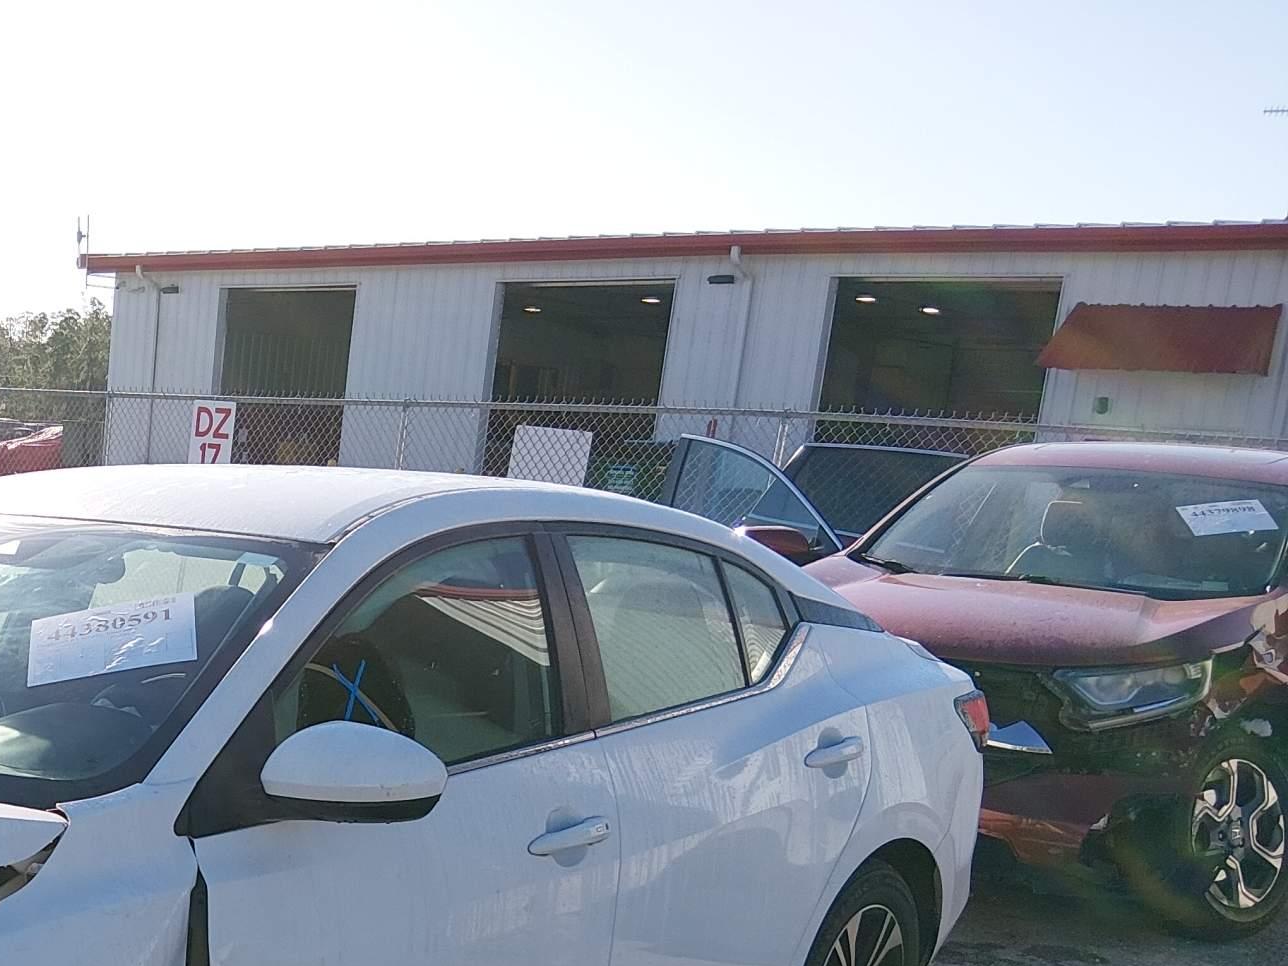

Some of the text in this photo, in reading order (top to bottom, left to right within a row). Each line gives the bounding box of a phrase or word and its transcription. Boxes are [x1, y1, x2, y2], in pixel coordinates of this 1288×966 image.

[195, 406, 232, 440] DZ
[199, 442, 221, 464] 17
[47, 608, 173, 641] 44380591
